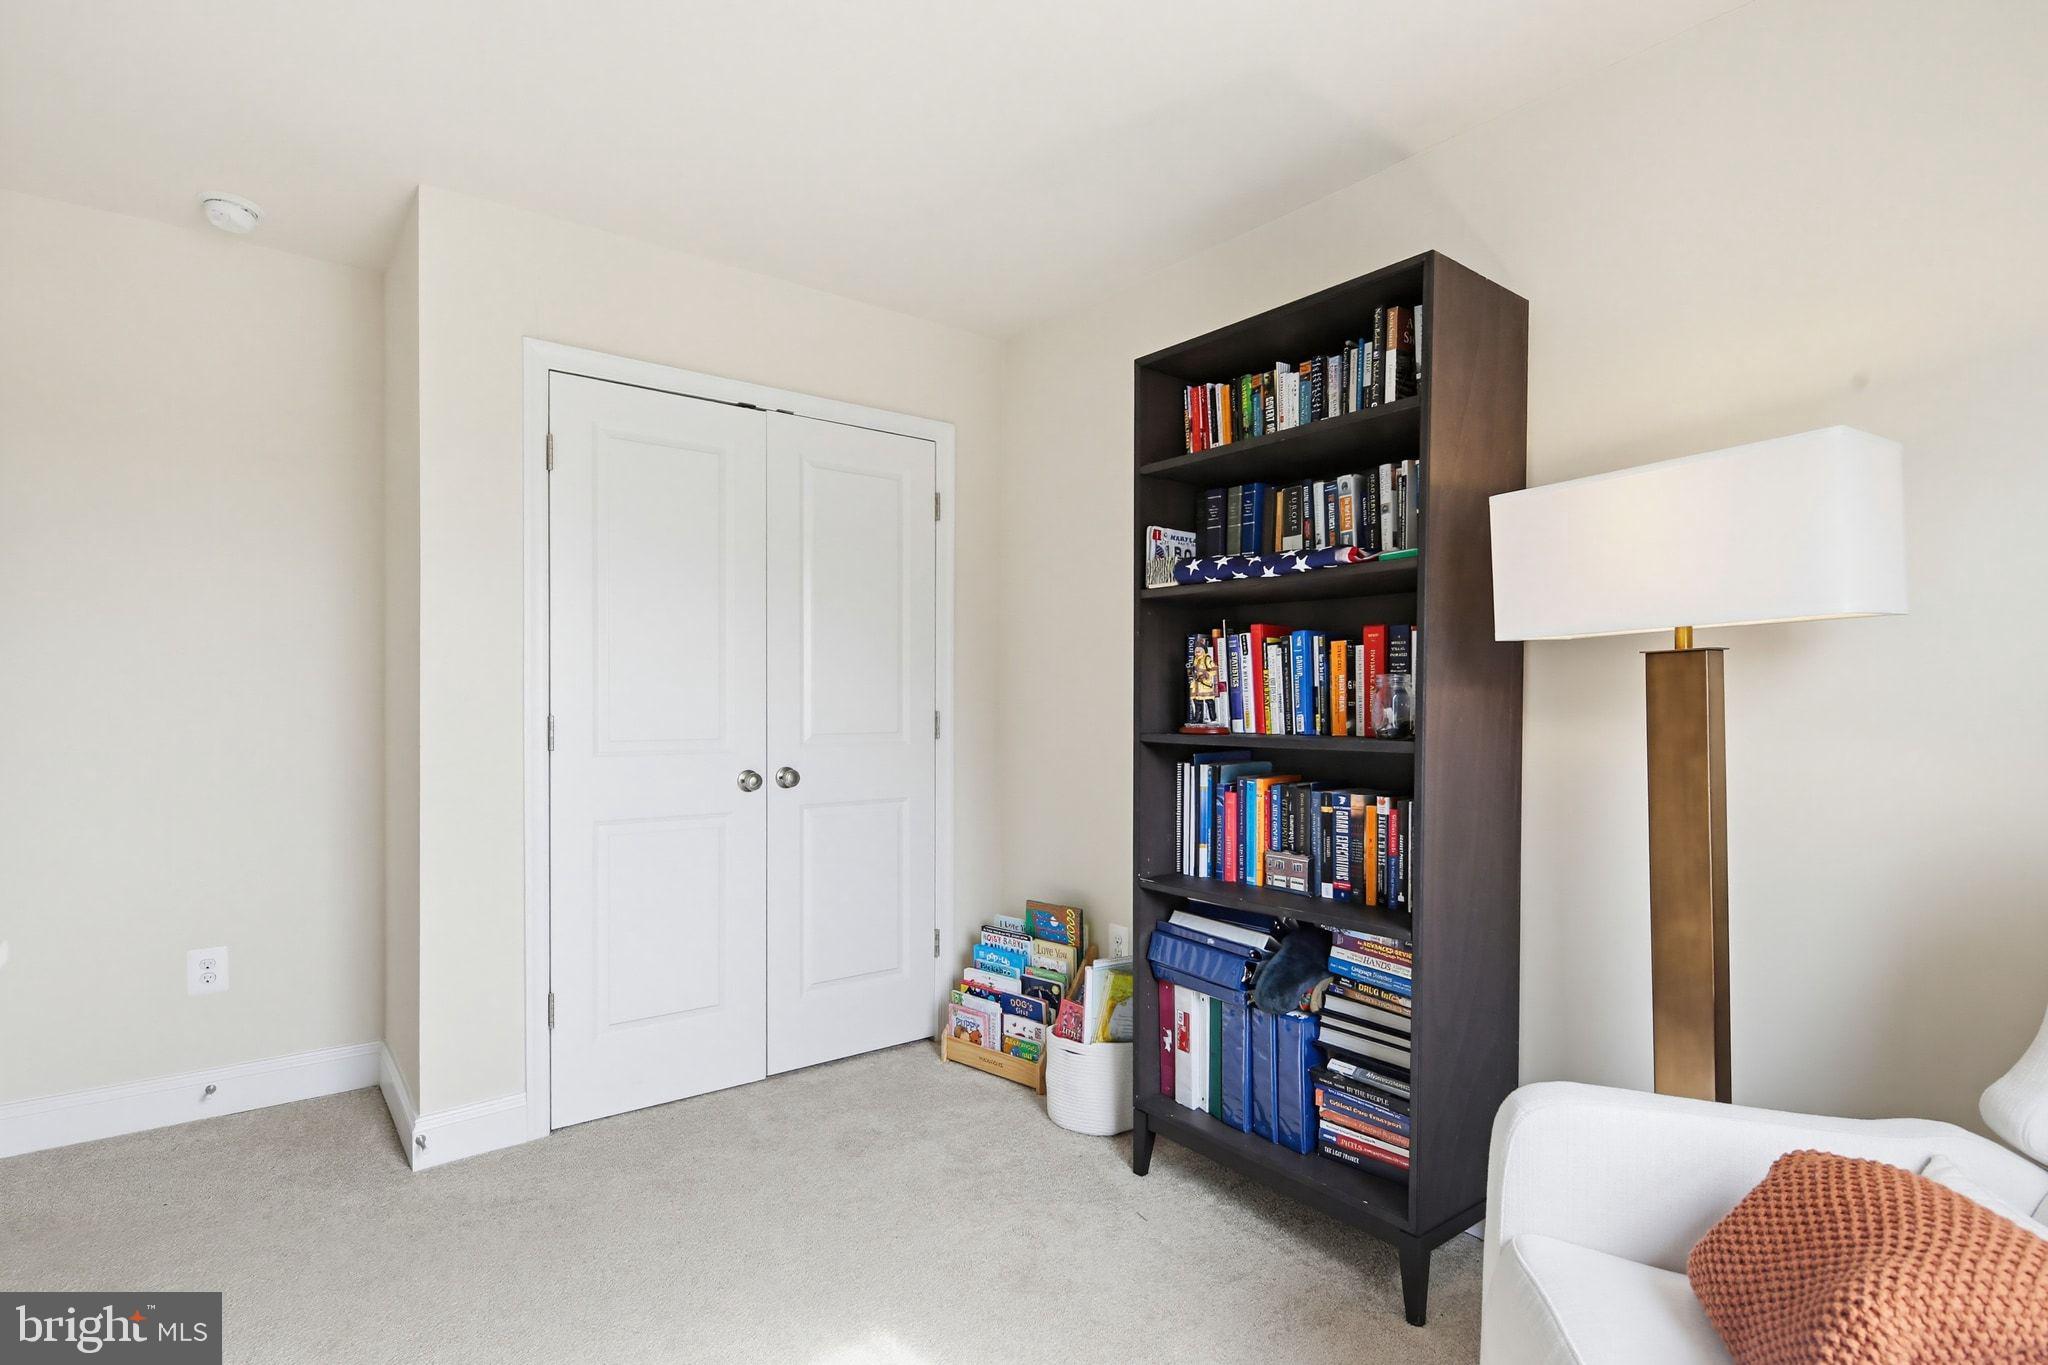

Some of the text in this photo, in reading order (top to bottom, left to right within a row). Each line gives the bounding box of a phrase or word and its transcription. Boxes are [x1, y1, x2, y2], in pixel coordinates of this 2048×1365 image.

[1231, 652, 1239, 688] STATISTICS
[1335, 810, 1349, 881] GRAND EXPECTATIONS
[1363, 956, 1392, 971] HANDS
[1358, 984, 1379, 996] DRUG
